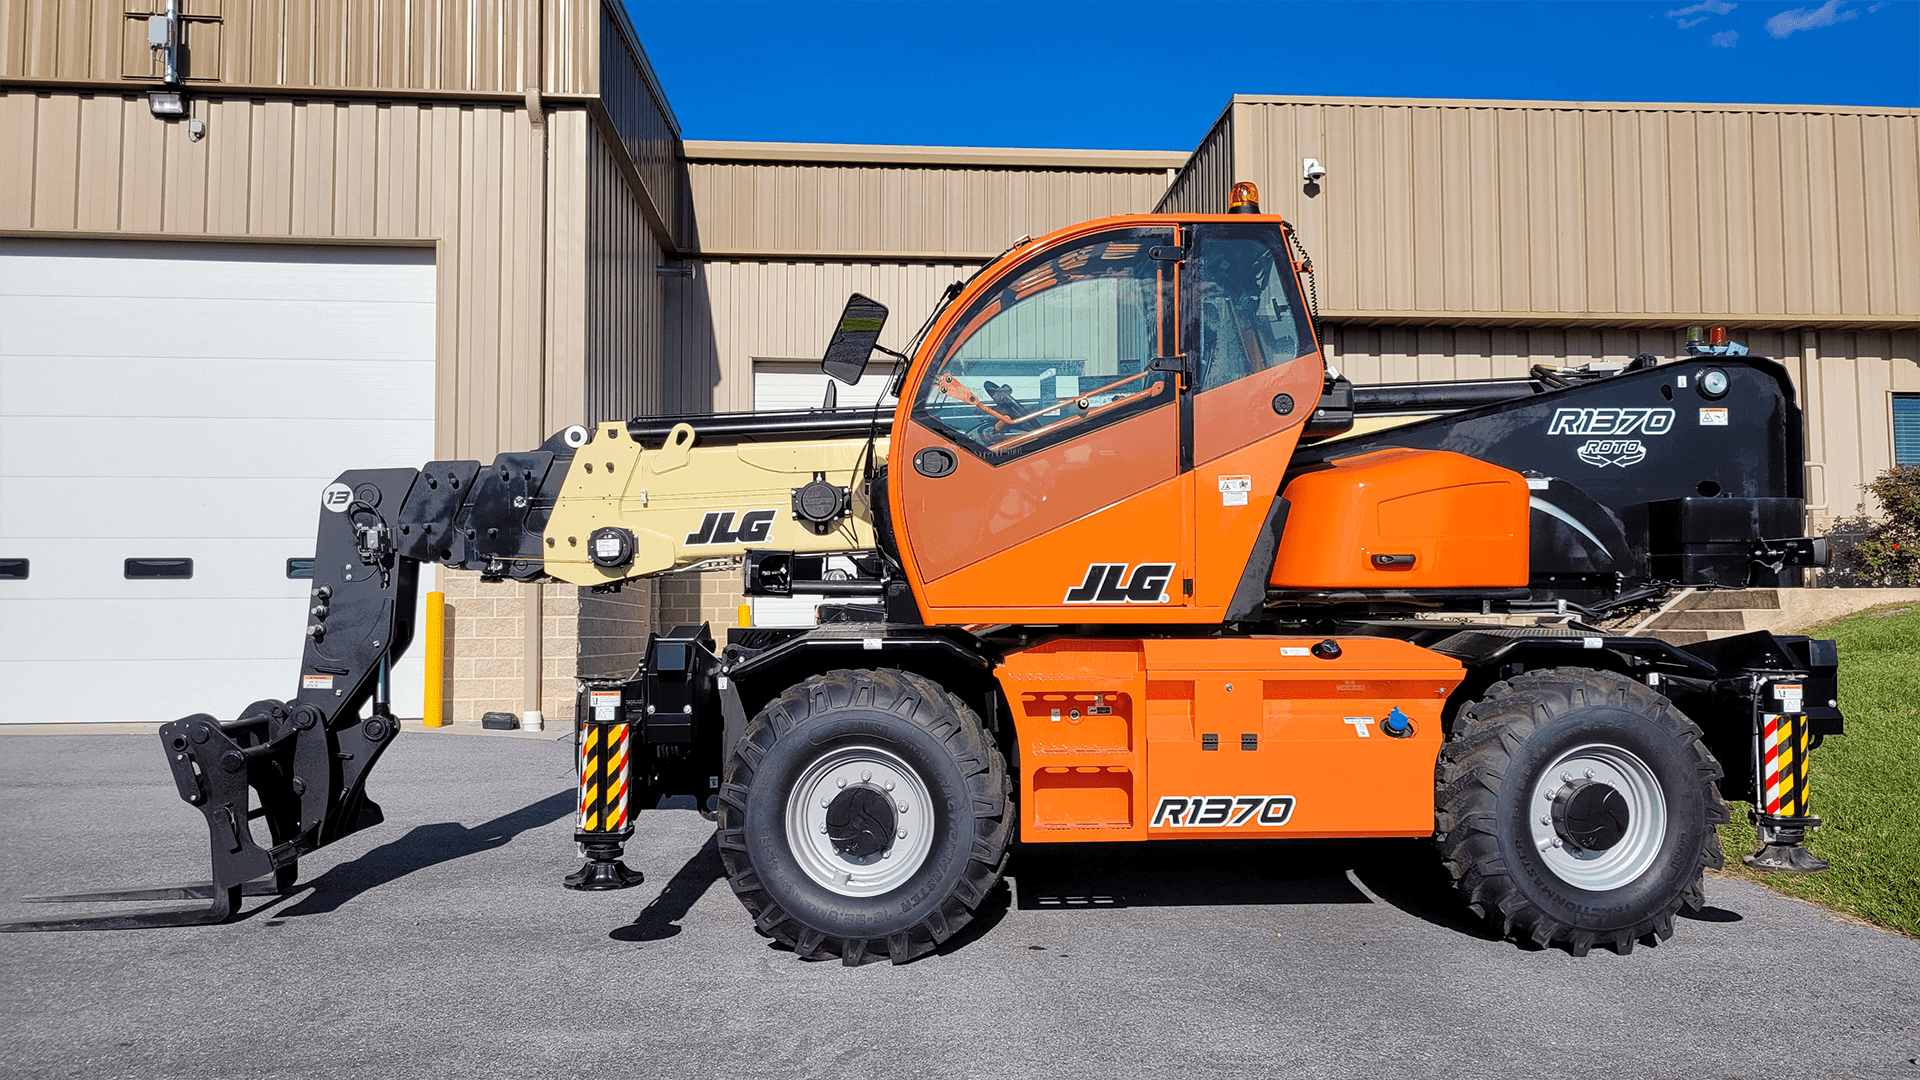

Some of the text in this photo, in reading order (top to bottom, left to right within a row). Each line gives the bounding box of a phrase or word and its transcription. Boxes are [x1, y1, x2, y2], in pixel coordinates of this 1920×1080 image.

[1547, 408, 1675, 435] R1370
[1585, 440, 1641, 454] ROTO
[327, 491, 351, 504] 13
[682, 508, 778, 547] JLG
[1063, 562, 1176, 604] JLG
[1149, 795, 1297, 828] R1370
